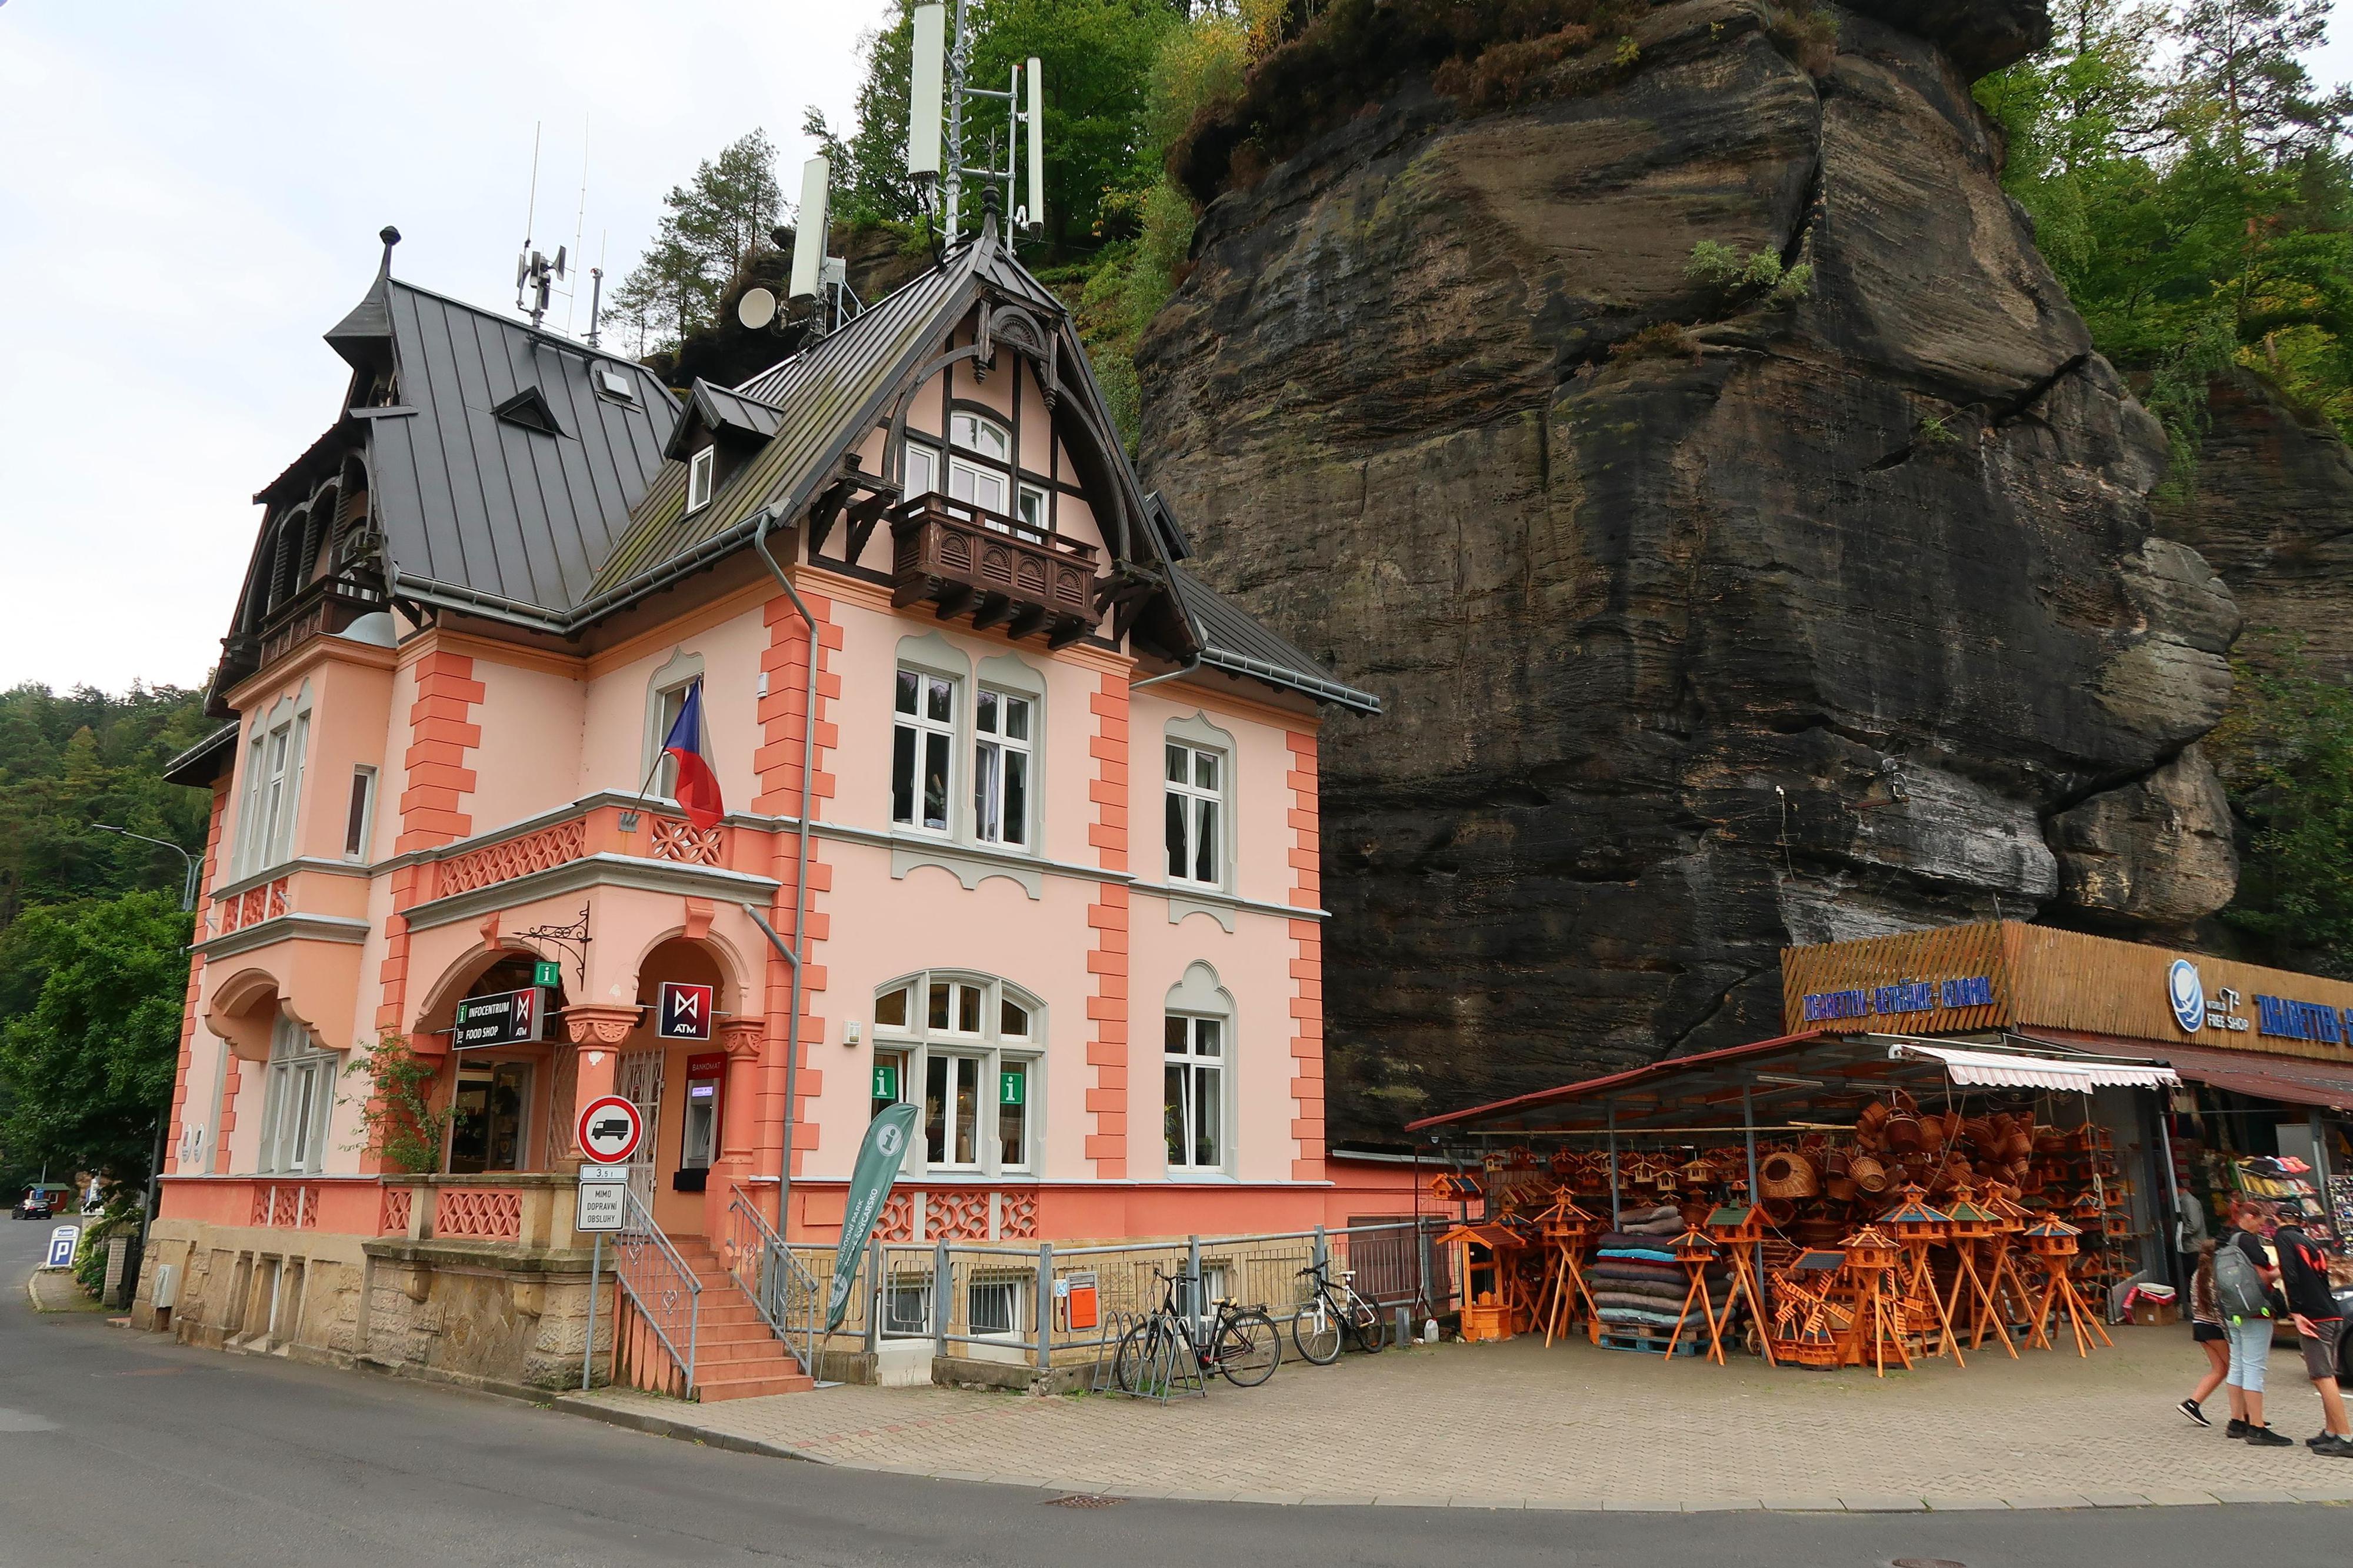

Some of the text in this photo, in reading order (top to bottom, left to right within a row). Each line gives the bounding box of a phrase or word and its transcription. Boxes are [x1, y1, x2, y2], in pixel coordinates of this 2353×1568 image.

[1803, 989, 1867, 1021] ZIGARETTEN
[1874, 978, 1933, 1014] GETRÄNKE
[1941, 975, 1994, 1008] ALKOHOL
[468, 1001, 510, 1018] INFOCENTRUM
[673, 1023, 696, 1034] ATM
[2207, 1013, 2249, 1032] FREE SHOP
[465, 1025, 499, 1040] FOOD SHOP
[515, 1026, 527, 1036] ATM
[692, 1062, 721, 1071] BANKOMAT
[595, 1190, 612, 1198] MIMO
[587, 1201, 618, 1210] DOPRAVNÍ
[852, 1197, 864, 1223] PARK
[587, 1215, 616, 1223] OBSLUHY
[855, 1188, 878, 1240] ŠVÝCARSKO
[55, 1242, 70, 1262] P
